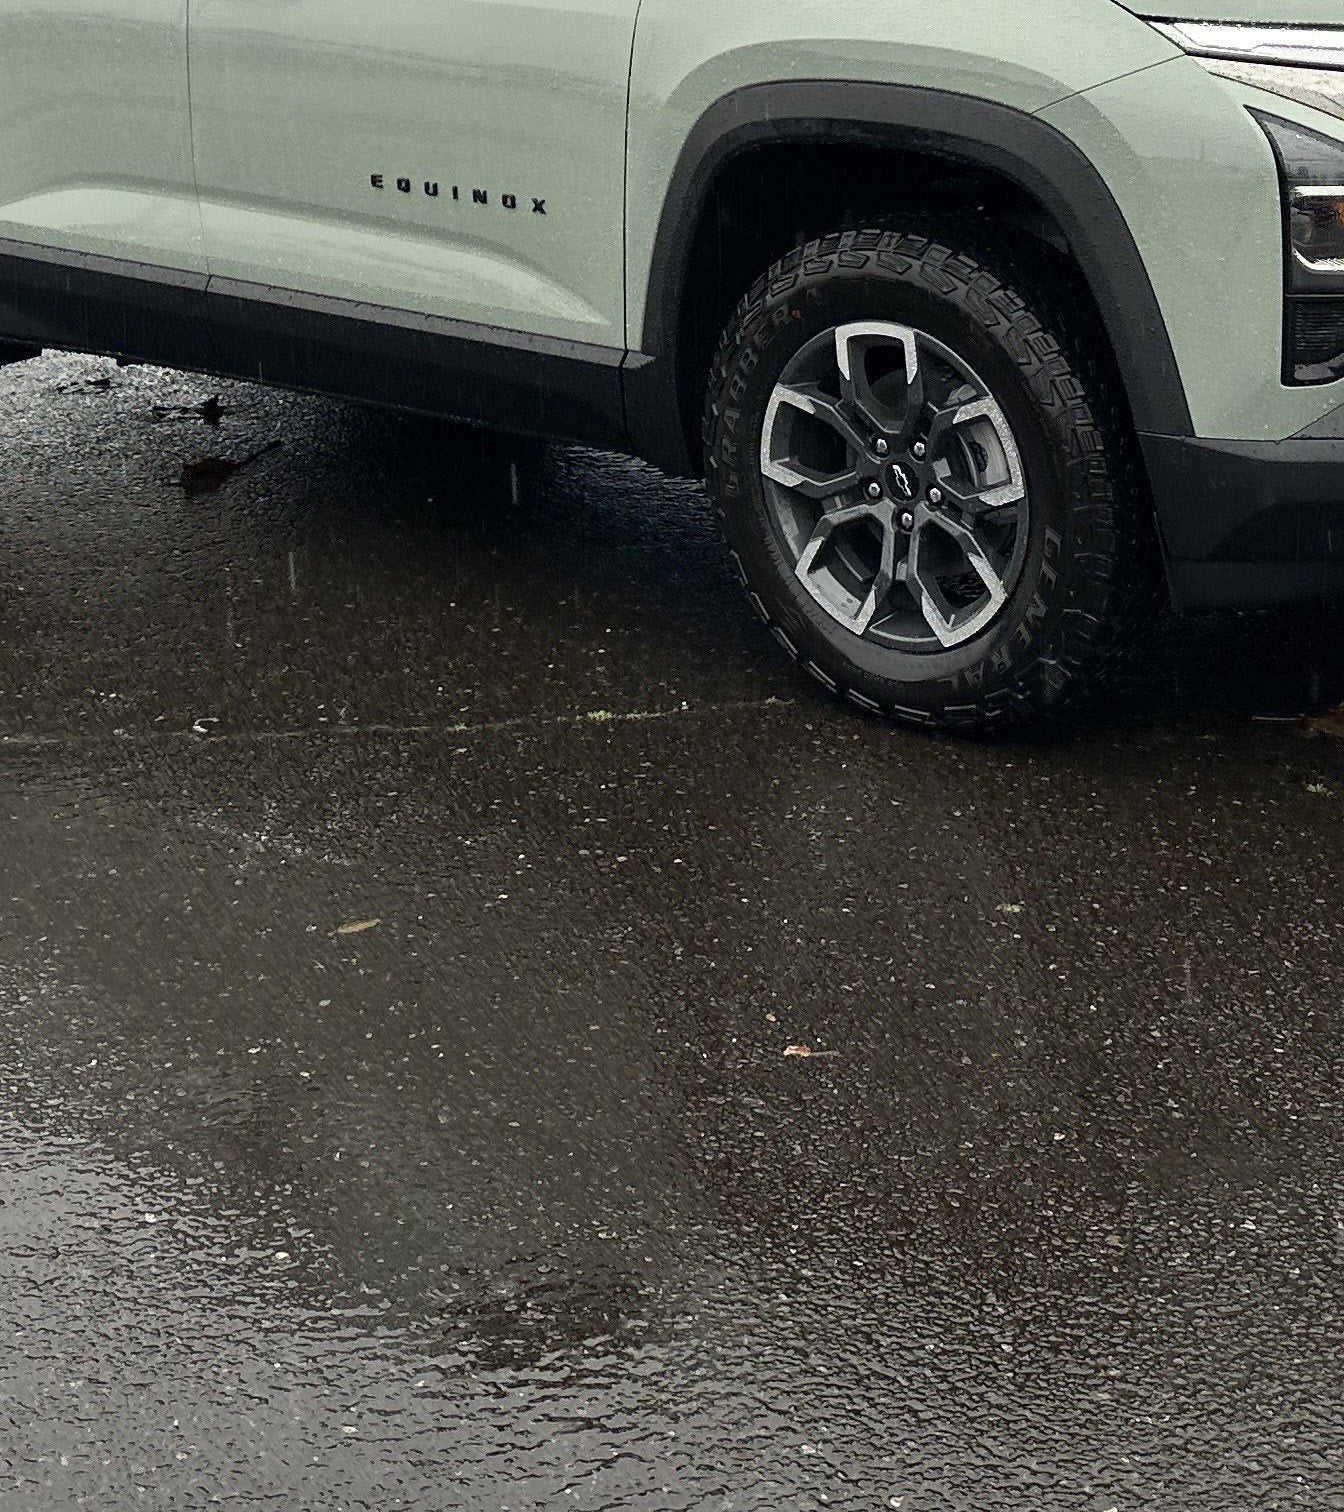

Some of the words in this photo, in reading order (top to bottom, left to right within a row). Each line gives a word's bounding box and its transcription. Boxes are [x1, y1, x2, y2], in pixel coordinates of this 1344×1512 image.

[370, 173, 547, 215] EQUINOX
[720, 302, 793, 498] GRABBER
[937, 526, 1063, 691] GENERAL
